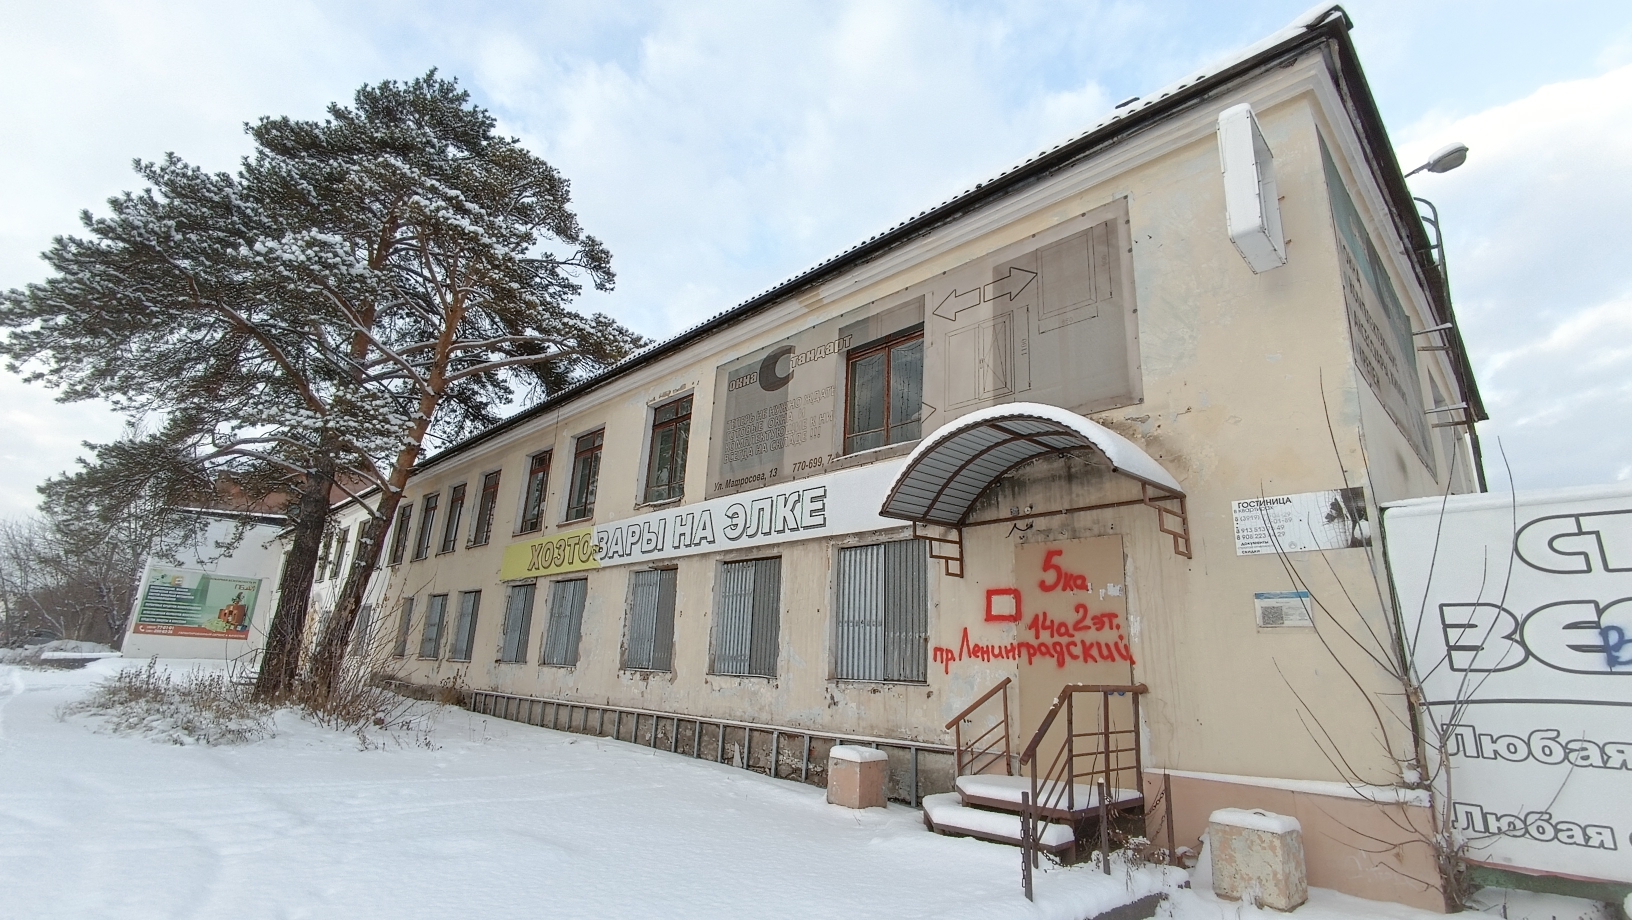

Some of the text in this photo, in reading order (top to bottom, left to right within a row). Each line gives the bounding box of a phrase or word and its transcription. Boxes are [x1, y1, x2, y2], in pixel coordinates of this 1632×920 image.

[728, 372, 758, 392] окна
[726, 412, 756, 431] ТЕПЕРЬ
[757, 408, 768, 422] НЕ
[768, 396, 802, 418] НУЖНО
[726, 407, 806, 441] ГОТОВЫЕ ОКНА И
[724, 444, 754, 465] ВСЕГДА
[756, 441, 769, 455] НА
[770, 430, 808, 452] СКЛАДЕ
[725, 418, 809, 453] КОМПЛЕКТУЮЩИЕ
[811, 415, 817, 427] К
[713, 481, 723, 492] Ул.
[725, 472, 767, 489] Матросова,
[768, 467, 778, 479] 13
[792, 456, 825, 474] 770-699,
[672, 509, 715, 550] НА
[723, 486, 827, 541] ЭЛКЕ
[1238, 496, 1292, 509] ГОСТИНИЦА
[1038, 550, 1090, 593] 5ка
[1028, 611, 1075, 640] 14а
[1442, 723, 1632, 770] Любая
[1451, 801, 1618, 851] Любая
